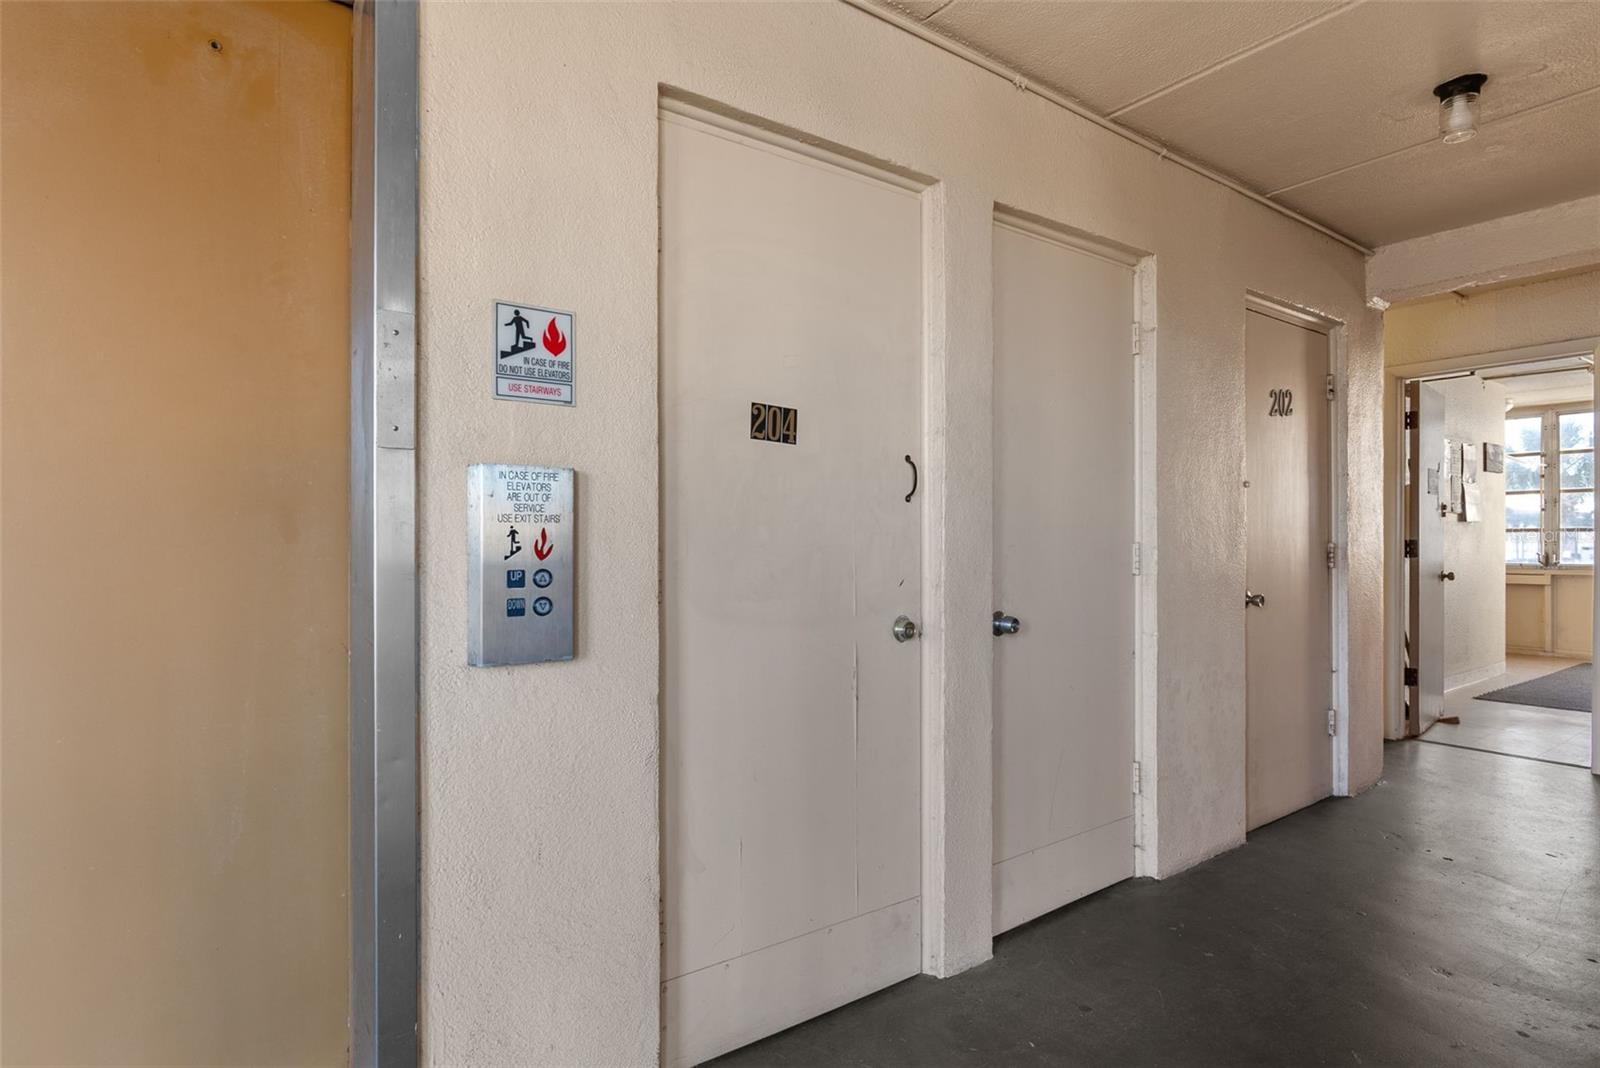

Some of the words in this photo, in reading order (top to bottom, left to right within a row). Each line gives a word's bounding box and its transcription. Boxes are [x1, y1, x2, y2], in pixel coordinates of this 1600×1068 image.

[523, 357, 530, 365] IN
[531, 357, 547, 367] CASE
[548, 360, 557, 368] OF
[558, 361, 570, 370] FIRE
[499, 364, 508, 373] DO
[509, 366, 522, 374] NOT
[524, 367, 536, 376] USE
[537, 369, 570, 380] ELEVATORS
[508, 384, 522, 392] USE
[524, 385, 561, 397] STAIRWAYS
[1269, 389, 1293, 417] 202
[751, 404, 797, 443] 204
[499, 471, 507, 479] IN
[508, 471, 529, 481] CASE
[531, 472, 542, 481] OF
[543, 472, 559, 482] FIRE
[507, 481, 552, 492] ELEVATORS
[507, 492, 521, 501] ARE
[524, 493, 539, 502] OUT
[541, 493, 552, 502] OF
[513, 503, 545, 513] SERVICE
[497, 513, 513, 523] USE
[514, 513, 531, 523] EXIT
[533, 513, 560, 524] STAIRS
[510, 570, 523, 581] UP
